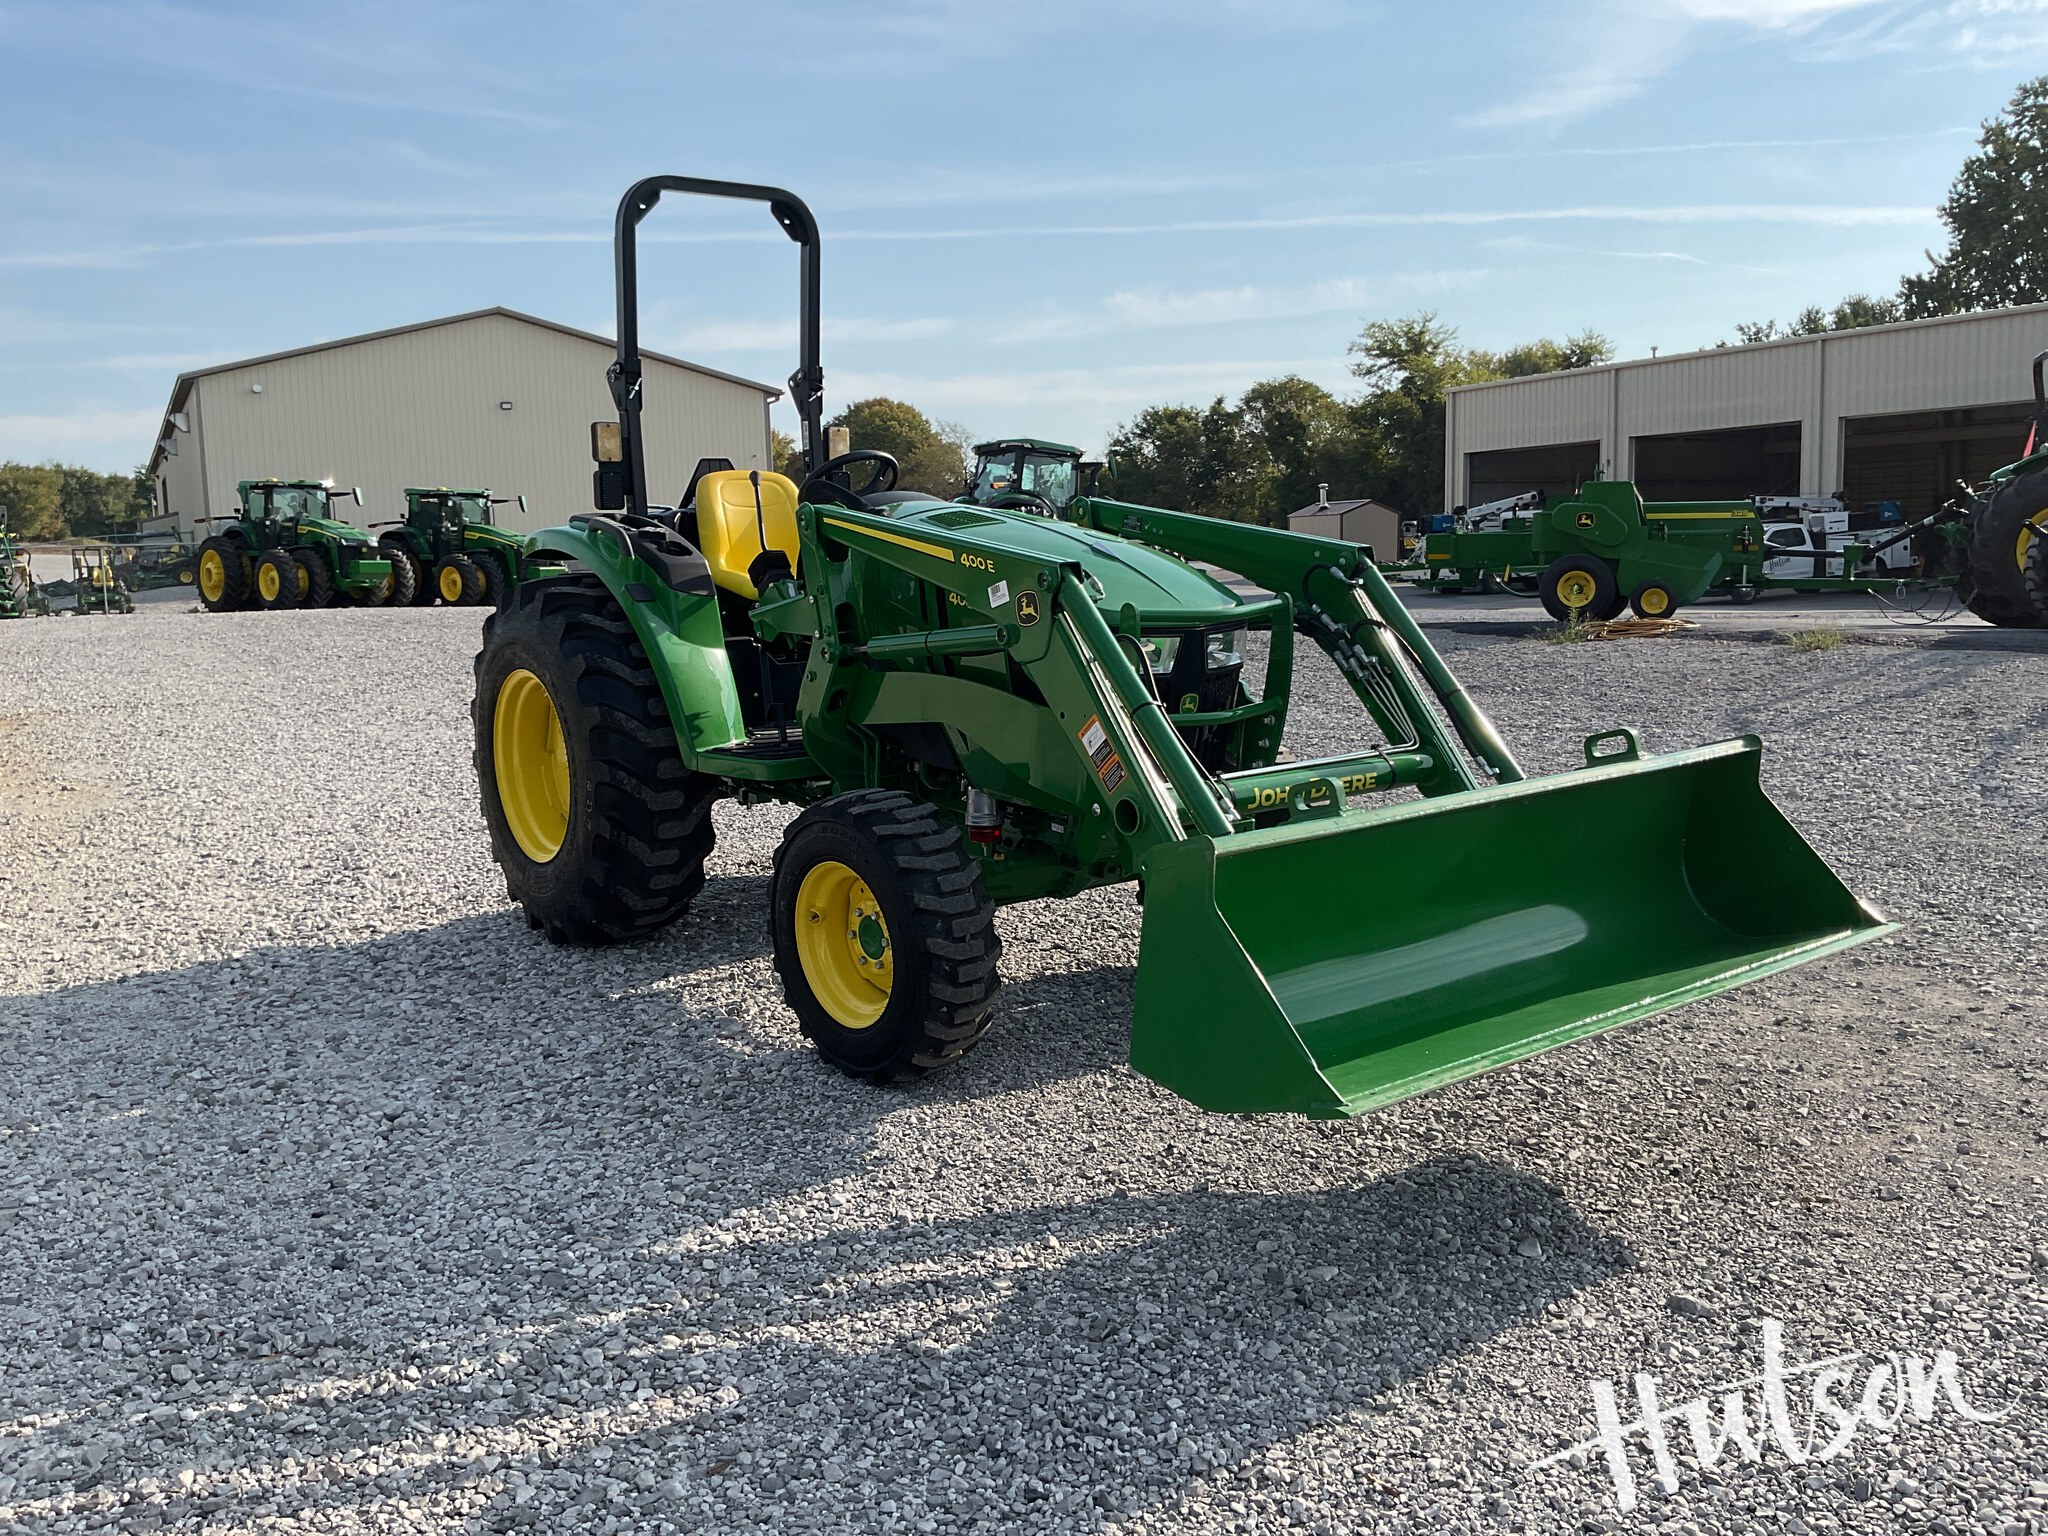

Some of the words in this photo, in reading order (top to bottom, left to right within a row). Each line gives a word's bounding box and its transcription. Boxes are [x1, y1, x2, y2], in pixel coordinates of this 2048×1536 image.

[960, 553, 986, 570] 400
[986, 559, 996, 573] E
[949, 592, 969, 606] 40
[1247, 784, 1305, 810] JOH
[1309, 772, 1377, 799] DERE
